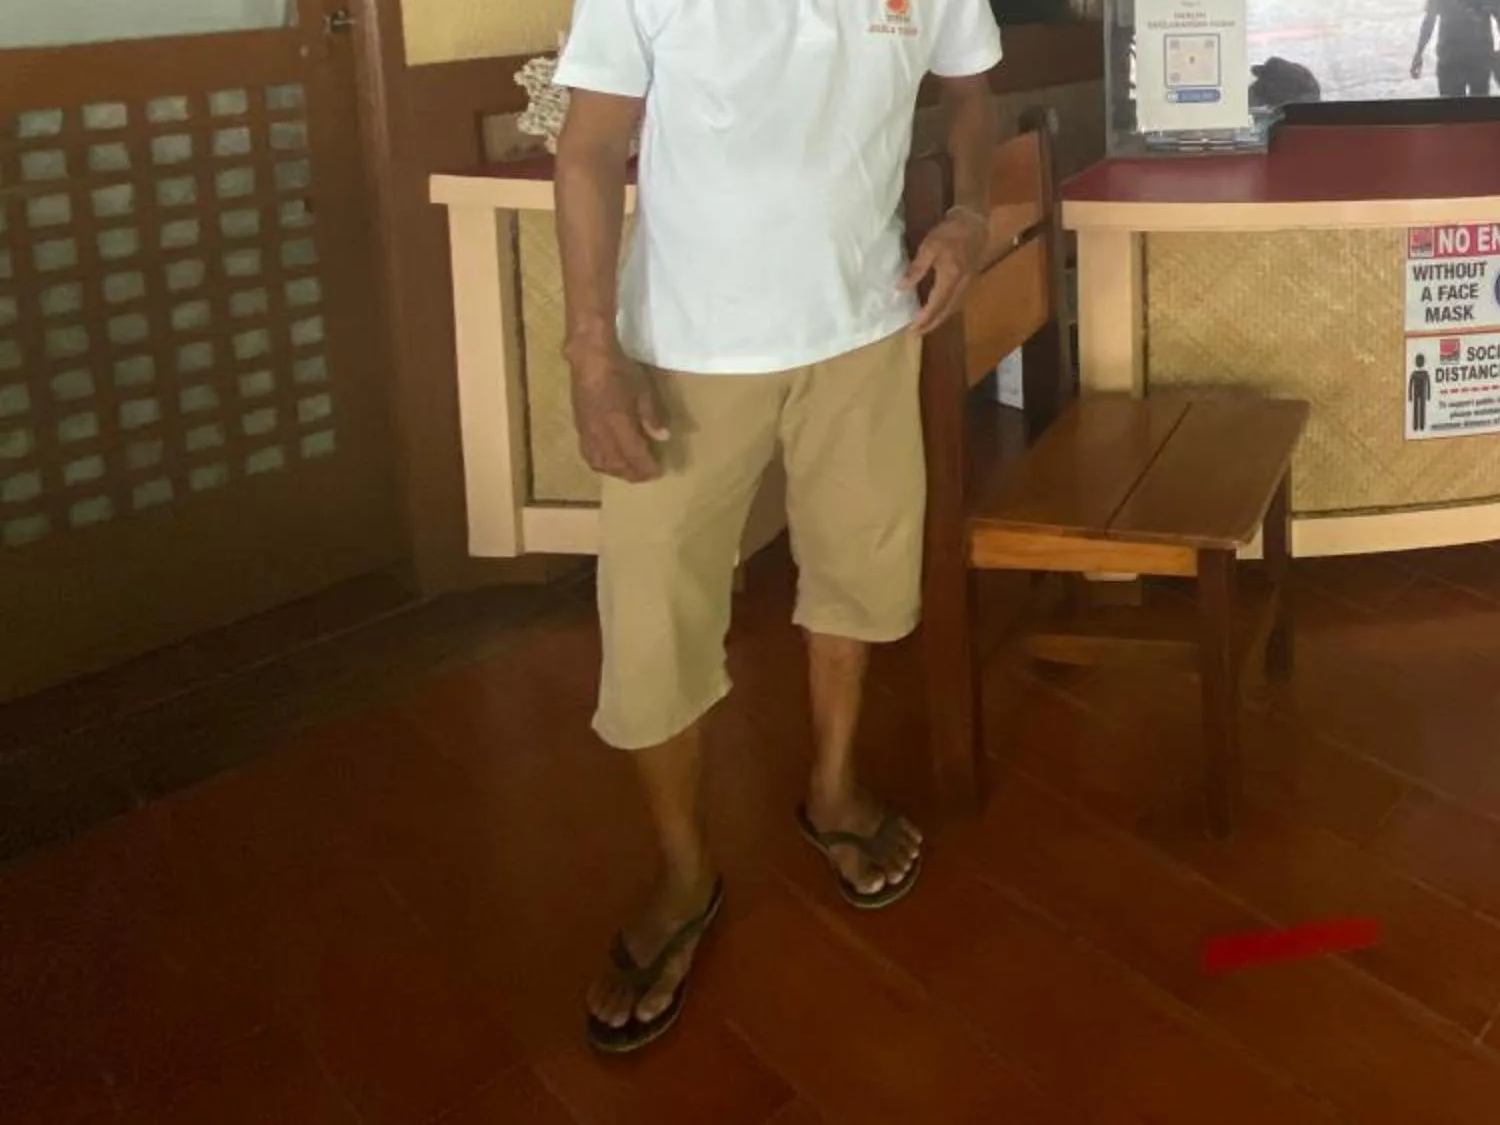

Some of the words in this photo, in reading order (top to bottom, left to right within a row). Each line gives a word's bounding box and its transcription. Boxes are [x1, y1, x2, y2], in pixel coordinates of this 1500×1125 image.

[1438, 227, 1470, 253] NO
[1412, 261, 1487, 282] WITHOUT
[1421, 286, 1433, 302] A
[1438, 284, 1479, 300] FACE
[1425, 305, 1475, 324] MASK
